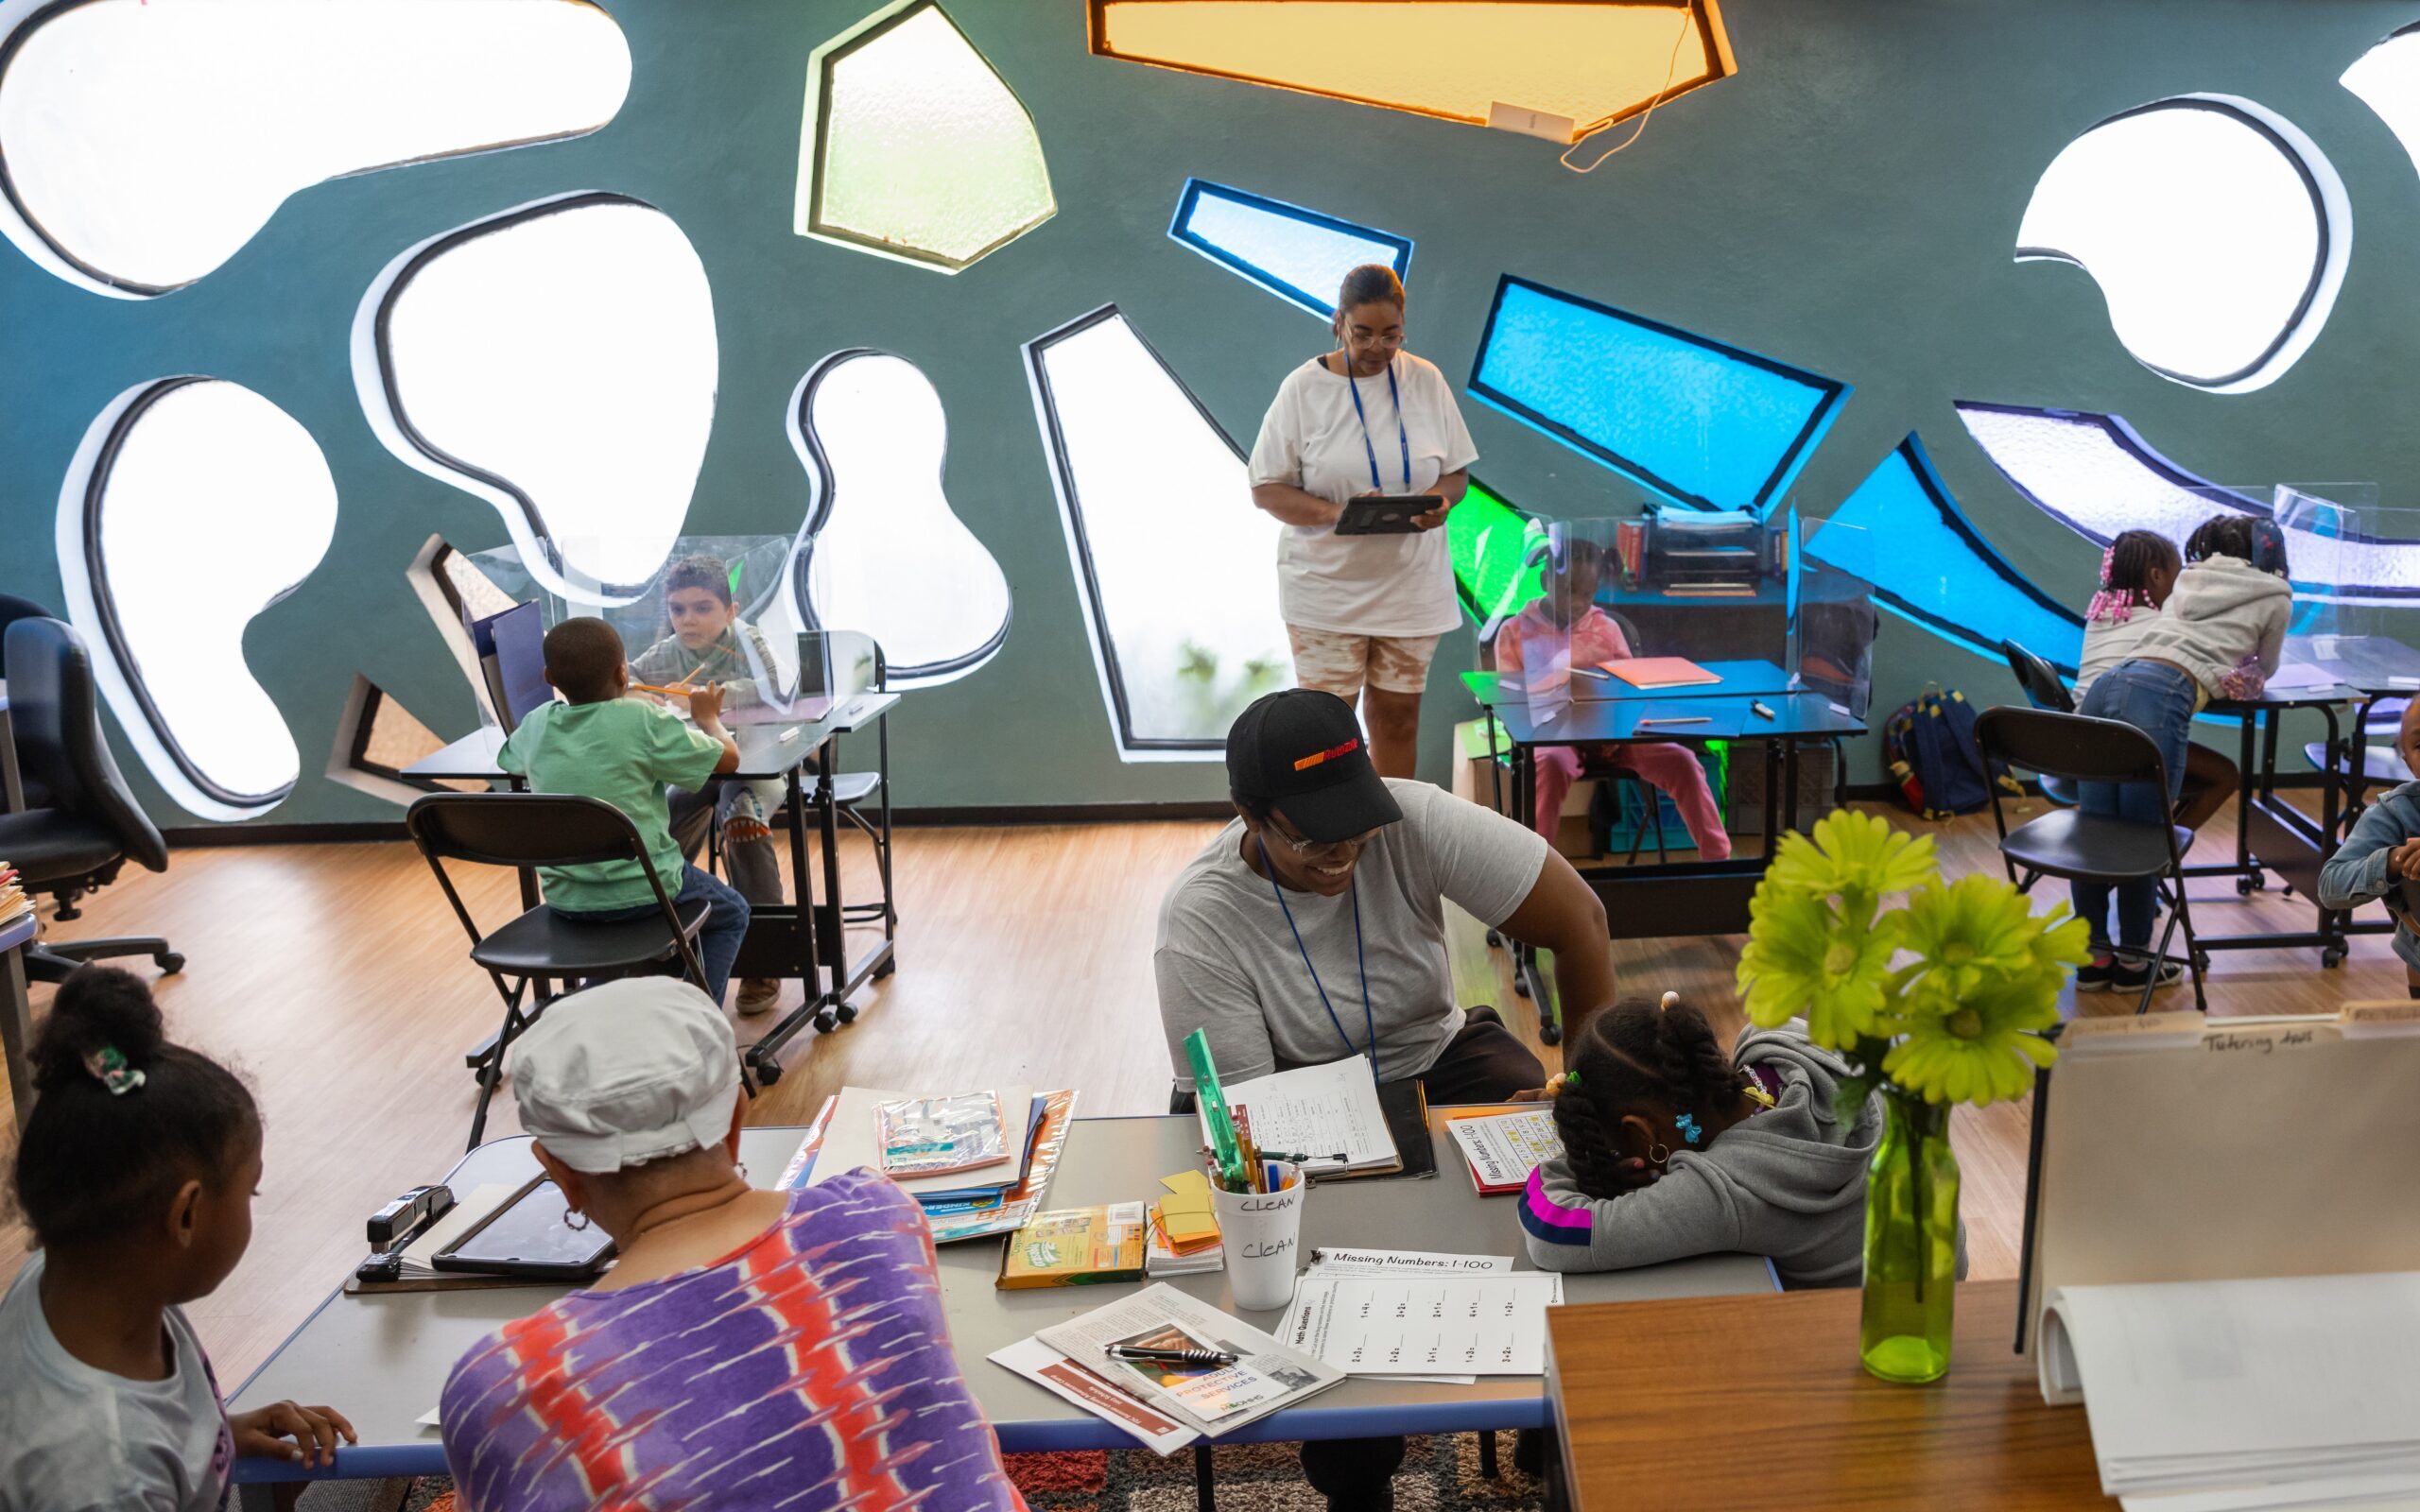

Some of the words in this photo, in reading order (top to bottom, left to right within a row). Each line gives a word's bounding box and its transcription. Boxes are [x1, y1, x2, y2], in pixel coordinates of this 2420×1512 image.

[1334, 1252, 1383, 1265] Missing
[1387, 1255, 1449, 1267] Numbers:
[1452, 1261, 1493, 1269] 1-100
[1298, 1306, 1311, 1331] Questions
[1295, 1331, 1305, 1344] Math
[1202, 1365, 1237, 1381] ADULT
[1176, 1370, 1247, 1397] PROTECTIVE
[1201, 1376, 1257, 1399] SERVICES
